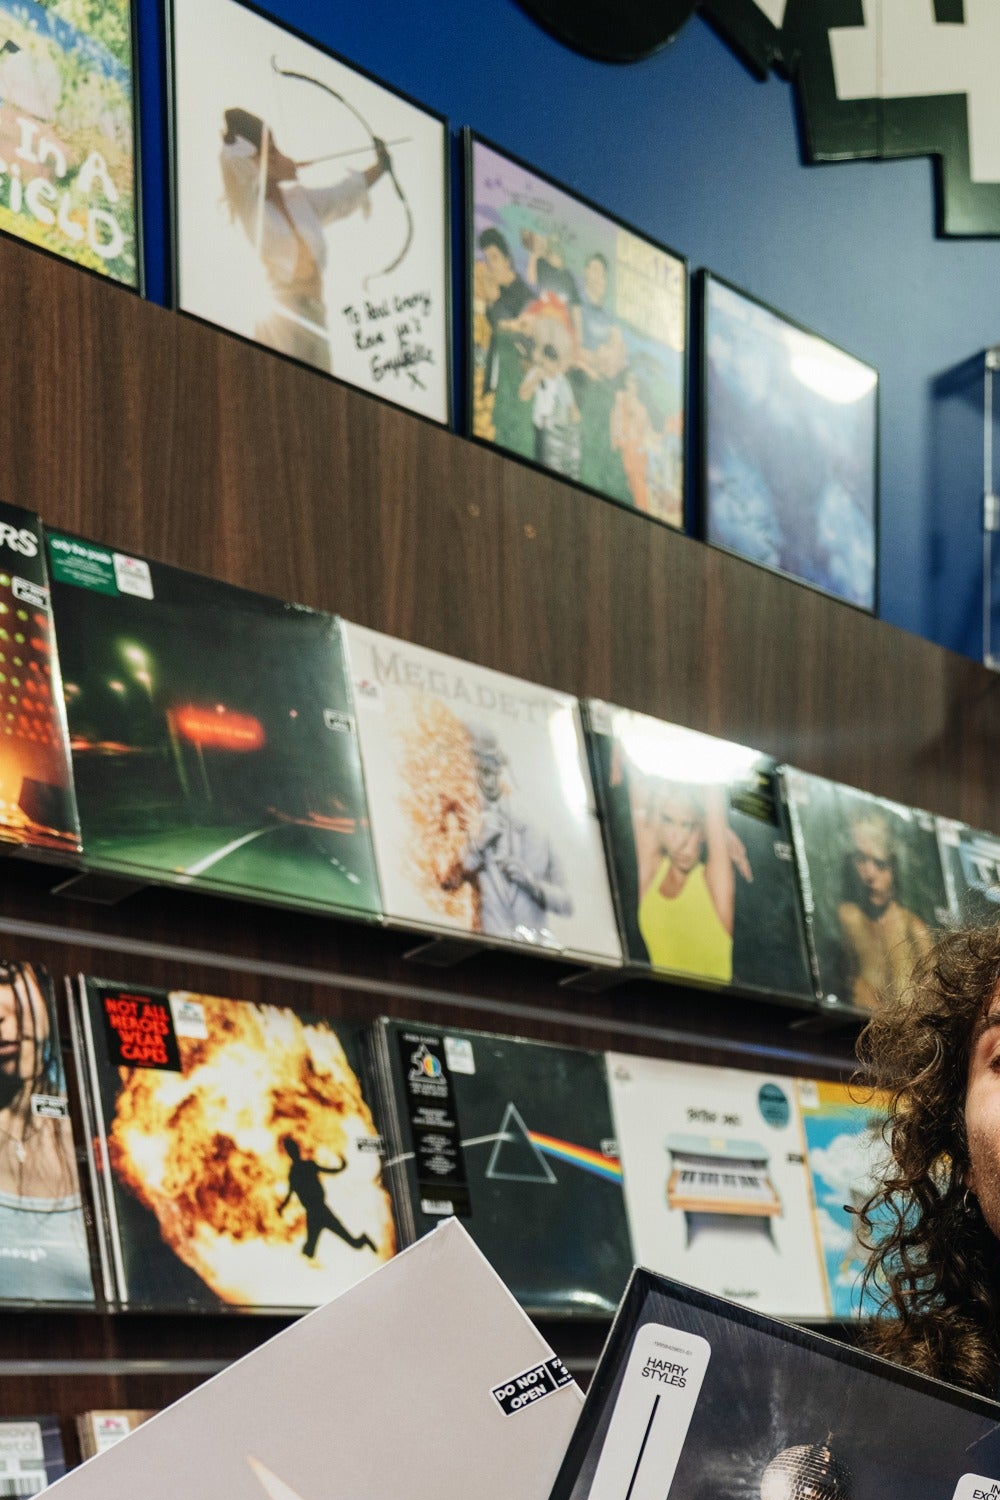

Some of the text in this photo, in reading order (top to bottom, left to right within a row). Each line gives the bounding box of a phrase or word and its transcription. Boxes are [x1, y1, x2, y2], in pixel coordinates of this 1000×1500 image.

[78, 151, 119, 203] A
[0, 521, 39, 557] RS
[366, 641, 552, 724] MEGADET
[104, 997, 169, 1022] NOT ALL
[109, 1014, 169, 1036] HEROES
[118, 1030, 167, 1052] WEAR
[120, 1045, 169, 1064] CAPES
[641, 1366, 687, 1388] STYLES
[646, 1356, 689, 1377] HARRY
[494, 1384, 516, 1401] DO
[516, 1366, 545, 1390] NOT
[510, 1384, 548, 1409] OPEN
